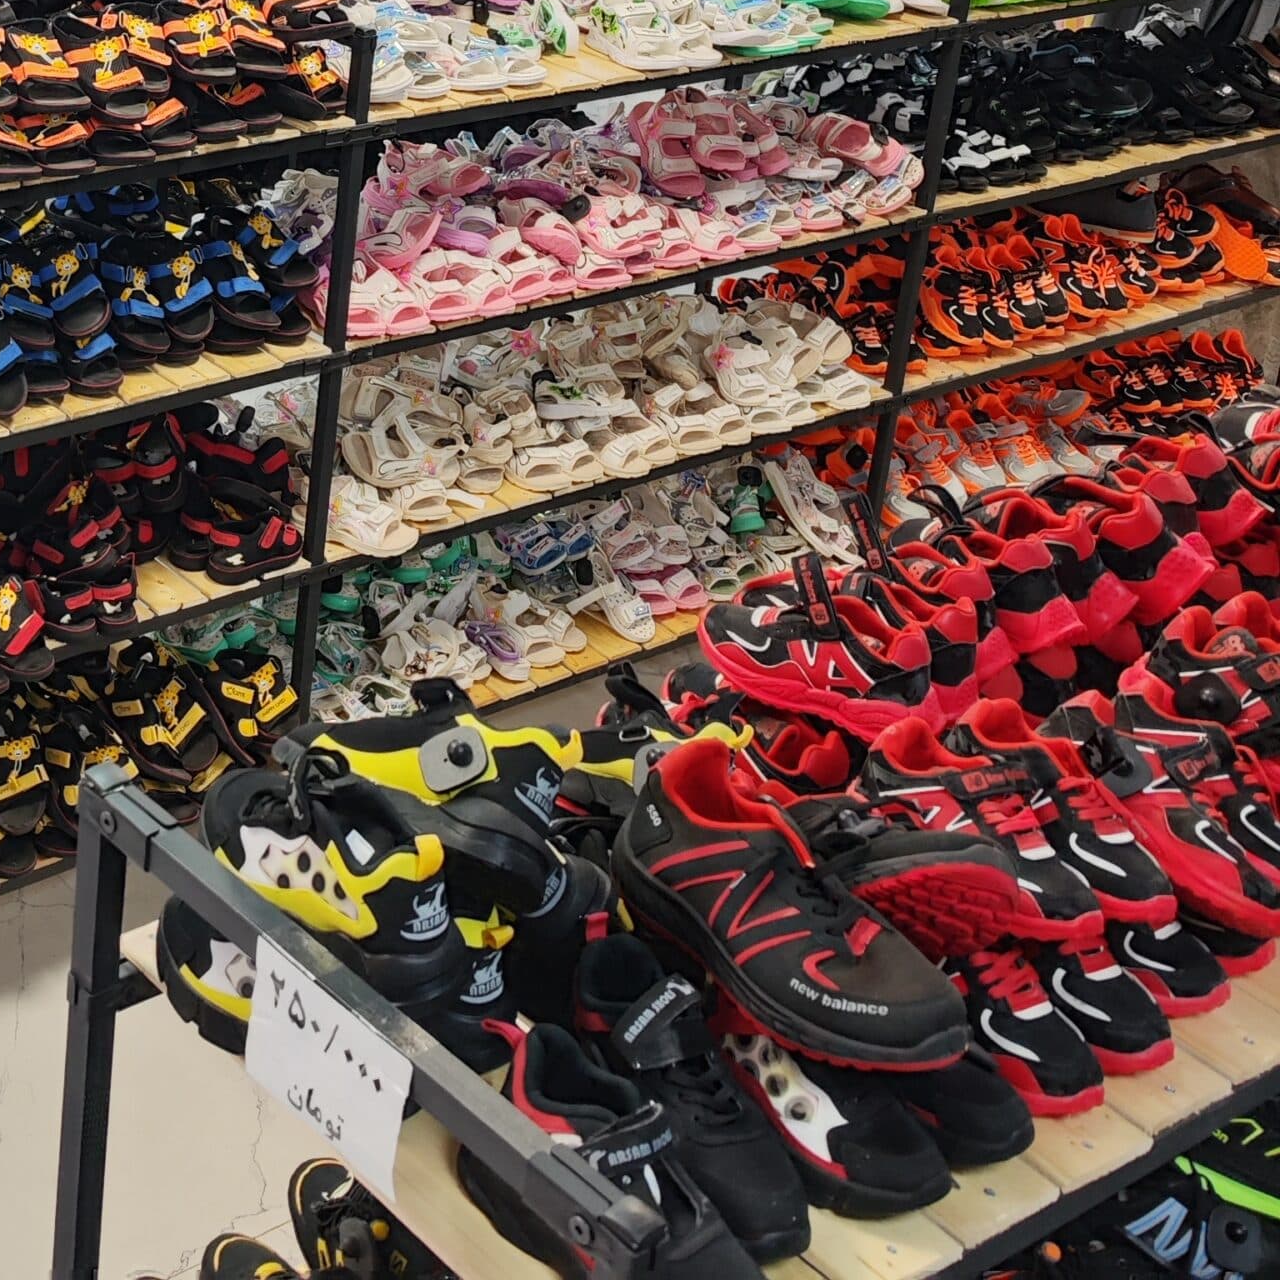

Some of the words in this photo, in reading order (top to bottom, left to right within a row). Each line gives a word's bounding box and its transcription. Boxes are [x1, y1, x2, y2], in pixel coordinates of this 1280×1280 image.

[646, 804, 662, 827] 550
[789, 978, 820, 1001] new
[821, 993, 889, 1016] balance
[270, 969, 383, 1093] ۲۵۰/۰۰۰
[287, 1083, 345, 1141] تومان
